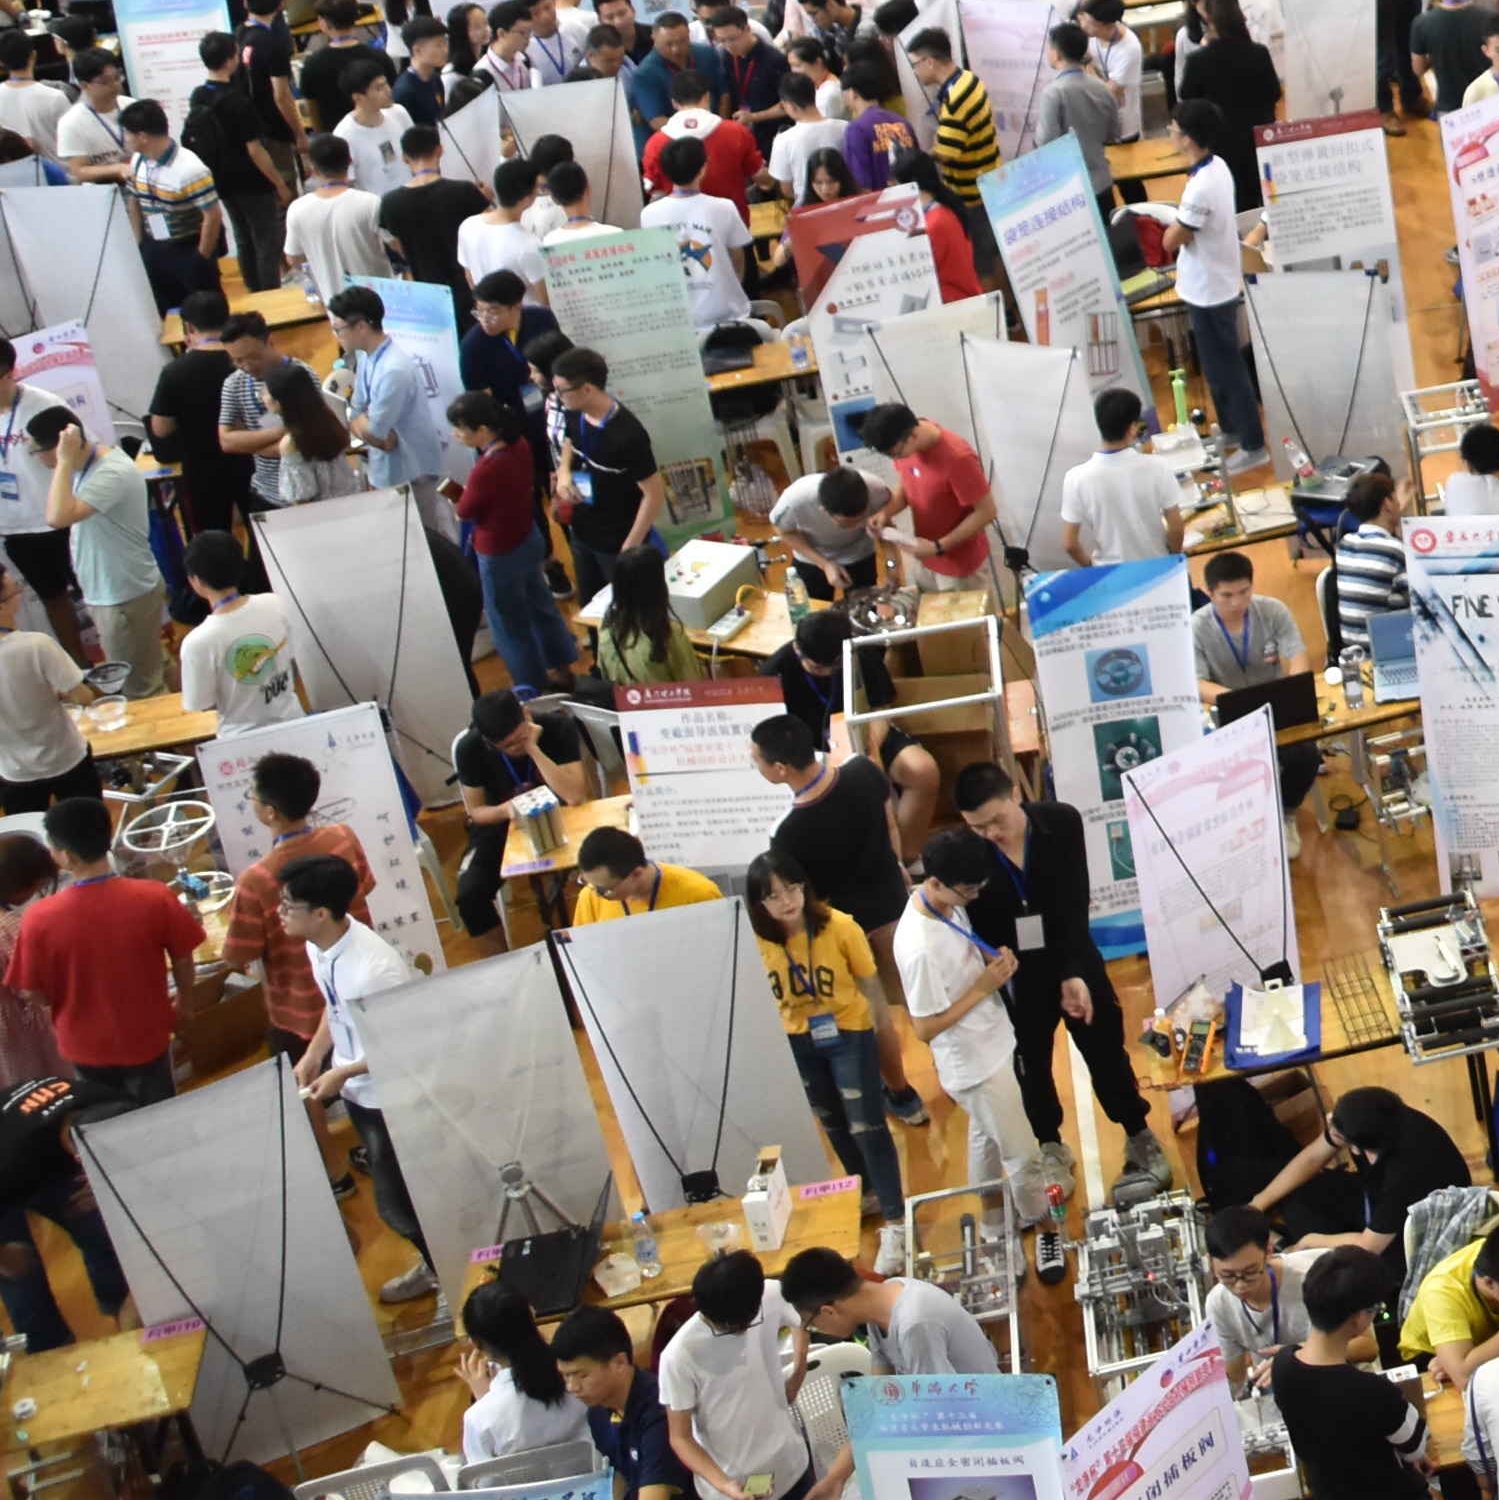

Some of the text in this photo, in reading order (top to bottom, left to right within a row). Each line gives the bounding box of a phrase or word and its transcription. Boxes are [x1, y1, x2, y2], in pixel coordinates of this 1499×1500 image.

[1002, 191, 1087, 246] 袋笼连接结构
